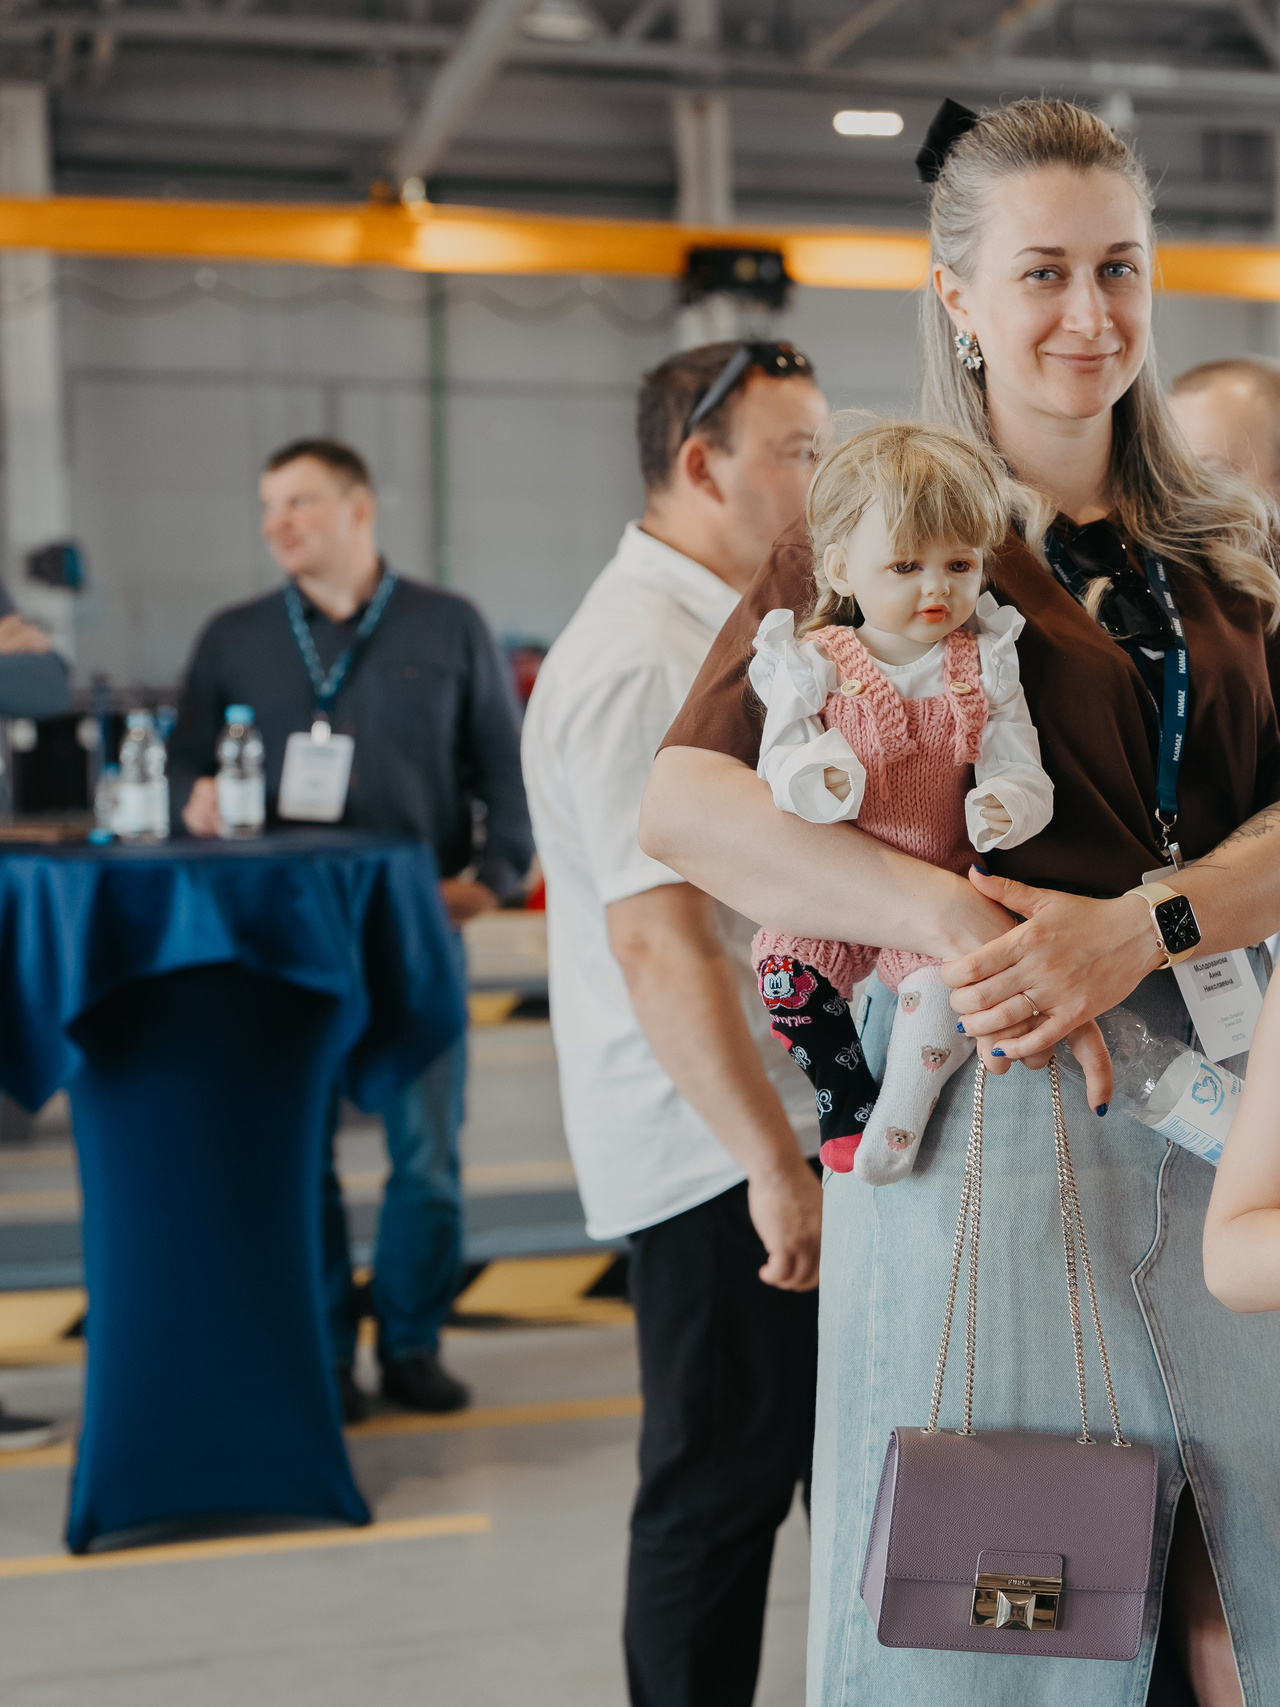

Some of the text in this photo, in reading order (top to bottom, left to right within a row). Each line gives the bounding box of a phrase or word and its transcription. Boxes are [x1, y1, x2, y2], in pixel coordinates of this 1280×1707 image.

[1178, 649, 1186, 674] KAMAZ
[1177, 690, 1186, 717] KAMAZ
[1172, 733, 1183, 761] KAMAZ
[1203, 978, 1234, 992] Николаевна
[1208, 970, 1222, 979] Анна
